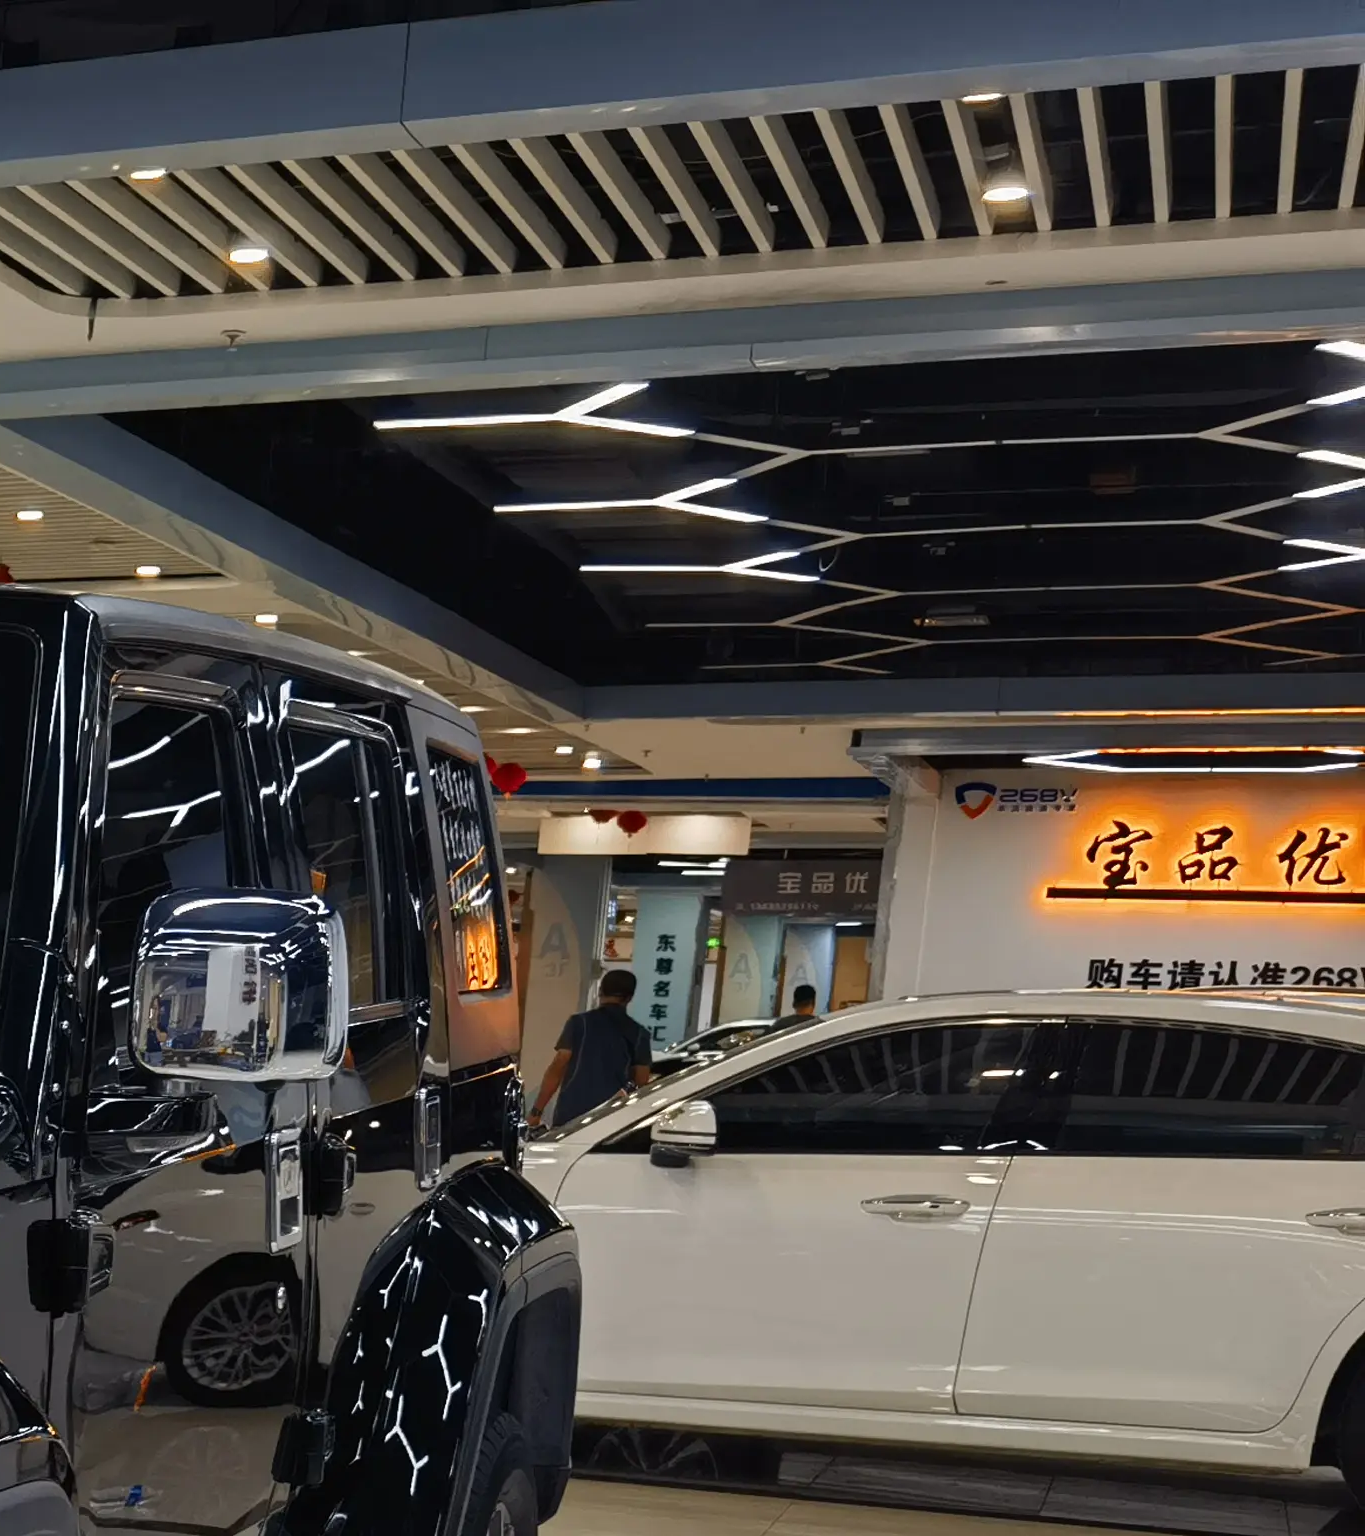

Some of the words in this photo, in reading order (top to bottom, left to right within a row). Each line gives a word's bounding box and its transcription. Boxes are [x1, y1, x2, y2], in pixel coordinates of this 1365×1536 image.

[1086, 820, 1349, 892] 宝品优
[1086, 958, 1365, 990] 购车请认准268
